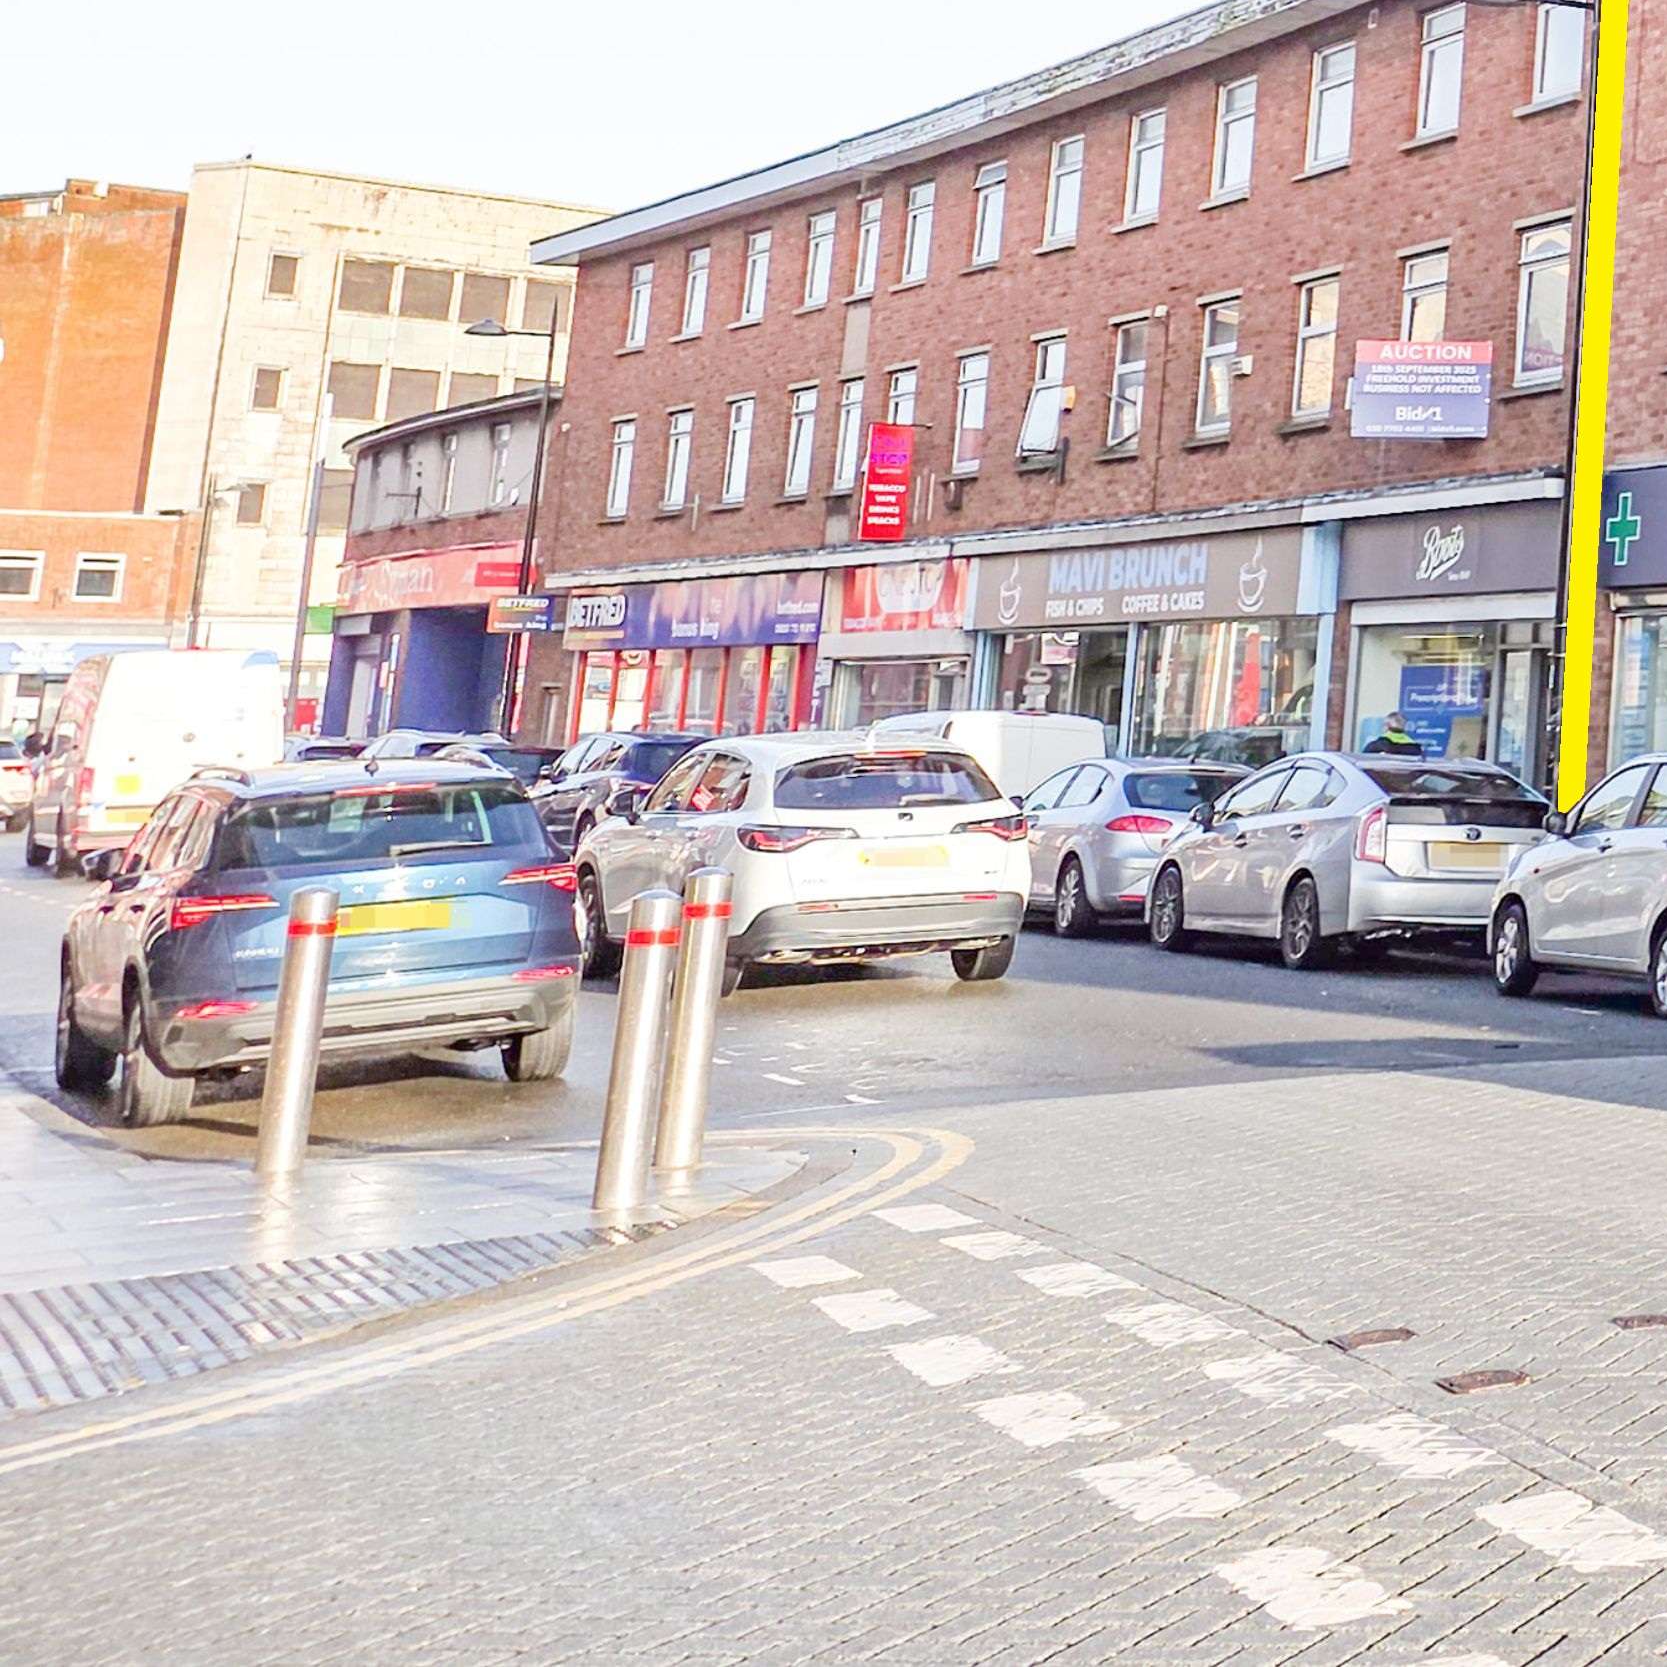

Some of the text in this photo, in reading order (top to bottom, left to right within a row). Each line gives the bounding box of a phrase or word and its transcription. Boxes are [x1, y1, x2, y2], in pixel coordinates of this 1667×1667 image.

[1380, 345, 1472, 359] AUCTION
[1366, 374, 1480, 384] FREEHOLD INVESTMENT
[1395, 365, 1452, 374] SEPTEMBER
[1363, 384, 1482, 394] BUSINESS NOT AFFECTED
[1049, 543, 1208, 593] MAVI BRUNCH
[571, 594, 627, 628] BETFRED
[1046, 598, 1104, 617] FISH & CHIPS
[1122, 591, 1204, 614] COFFEE & CAKES
[700, 619, 720, 641] king
